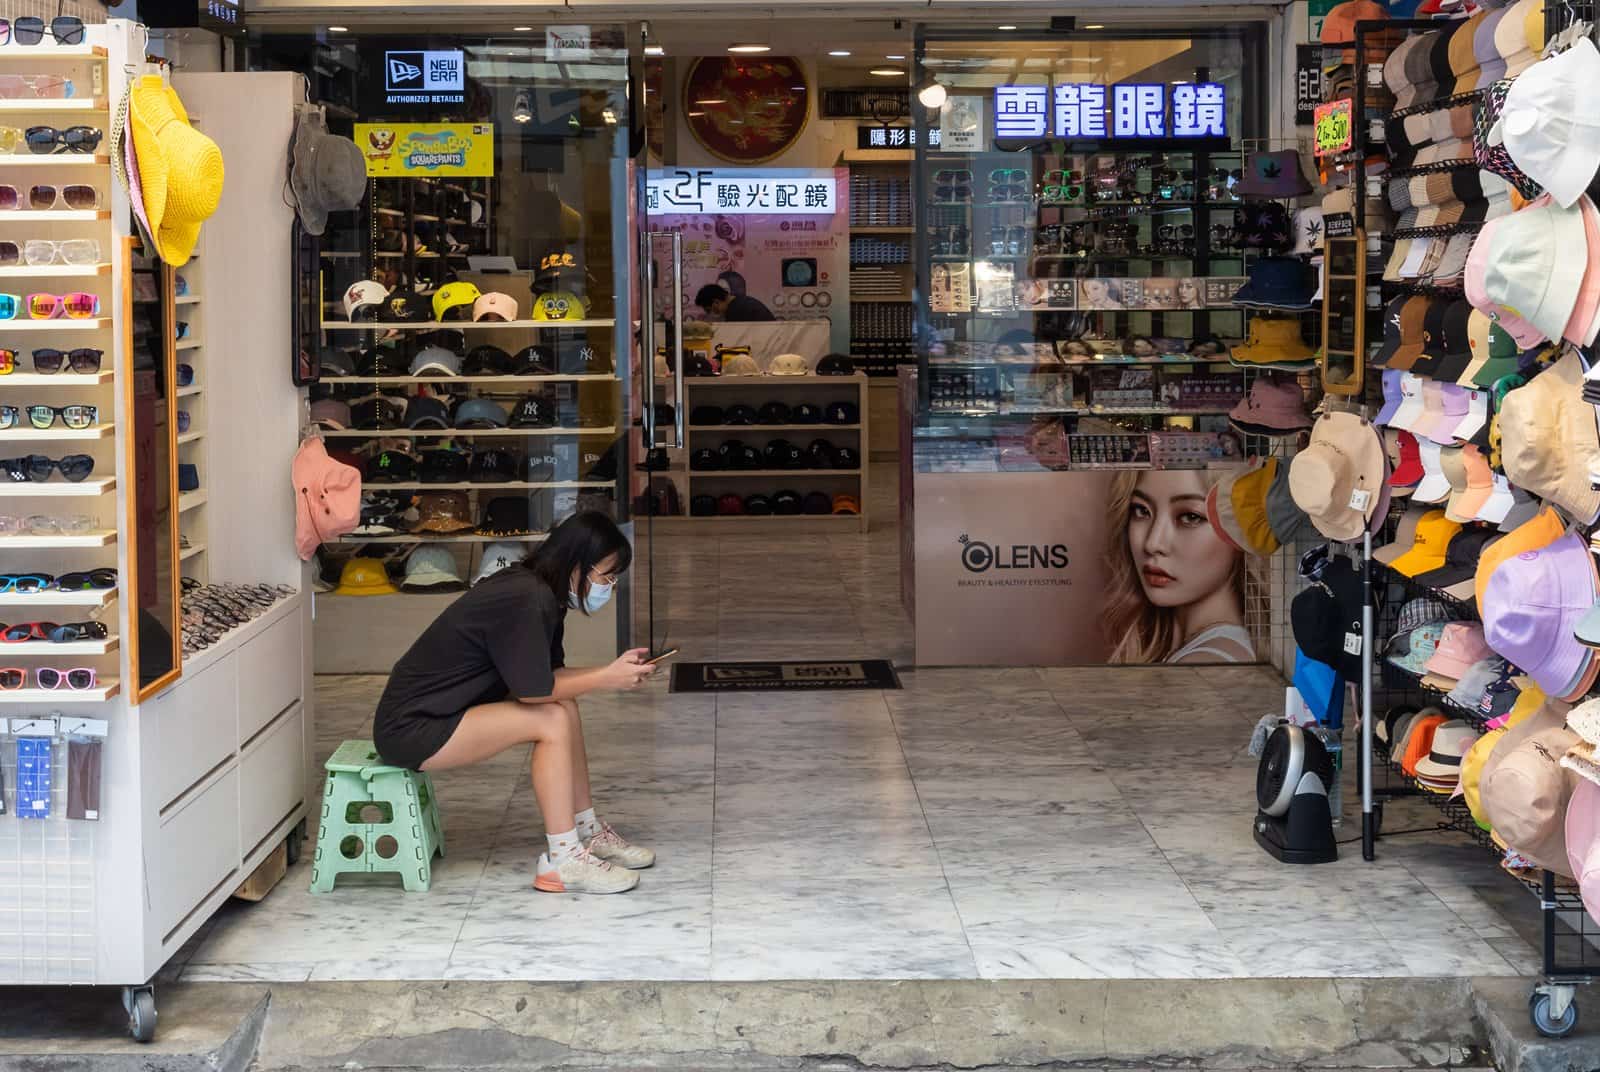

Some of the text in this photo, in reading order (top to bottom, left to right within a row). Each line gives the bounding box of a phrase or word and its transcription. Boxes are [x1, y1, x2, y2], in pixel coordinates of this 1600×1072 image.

[430, 59, 458, 70] NEW
[430, 71, 458, 82] ERA
[386, 95, 465, 104] AUTHORIZED RETAILER
[996, 84, 1225, 137] 雪龍眼鏡
[674, 170, 713, 199] 2F
[717, 183, 828, 208] 驗光配鏡
[961, 541, 1070, 573] OLENS
